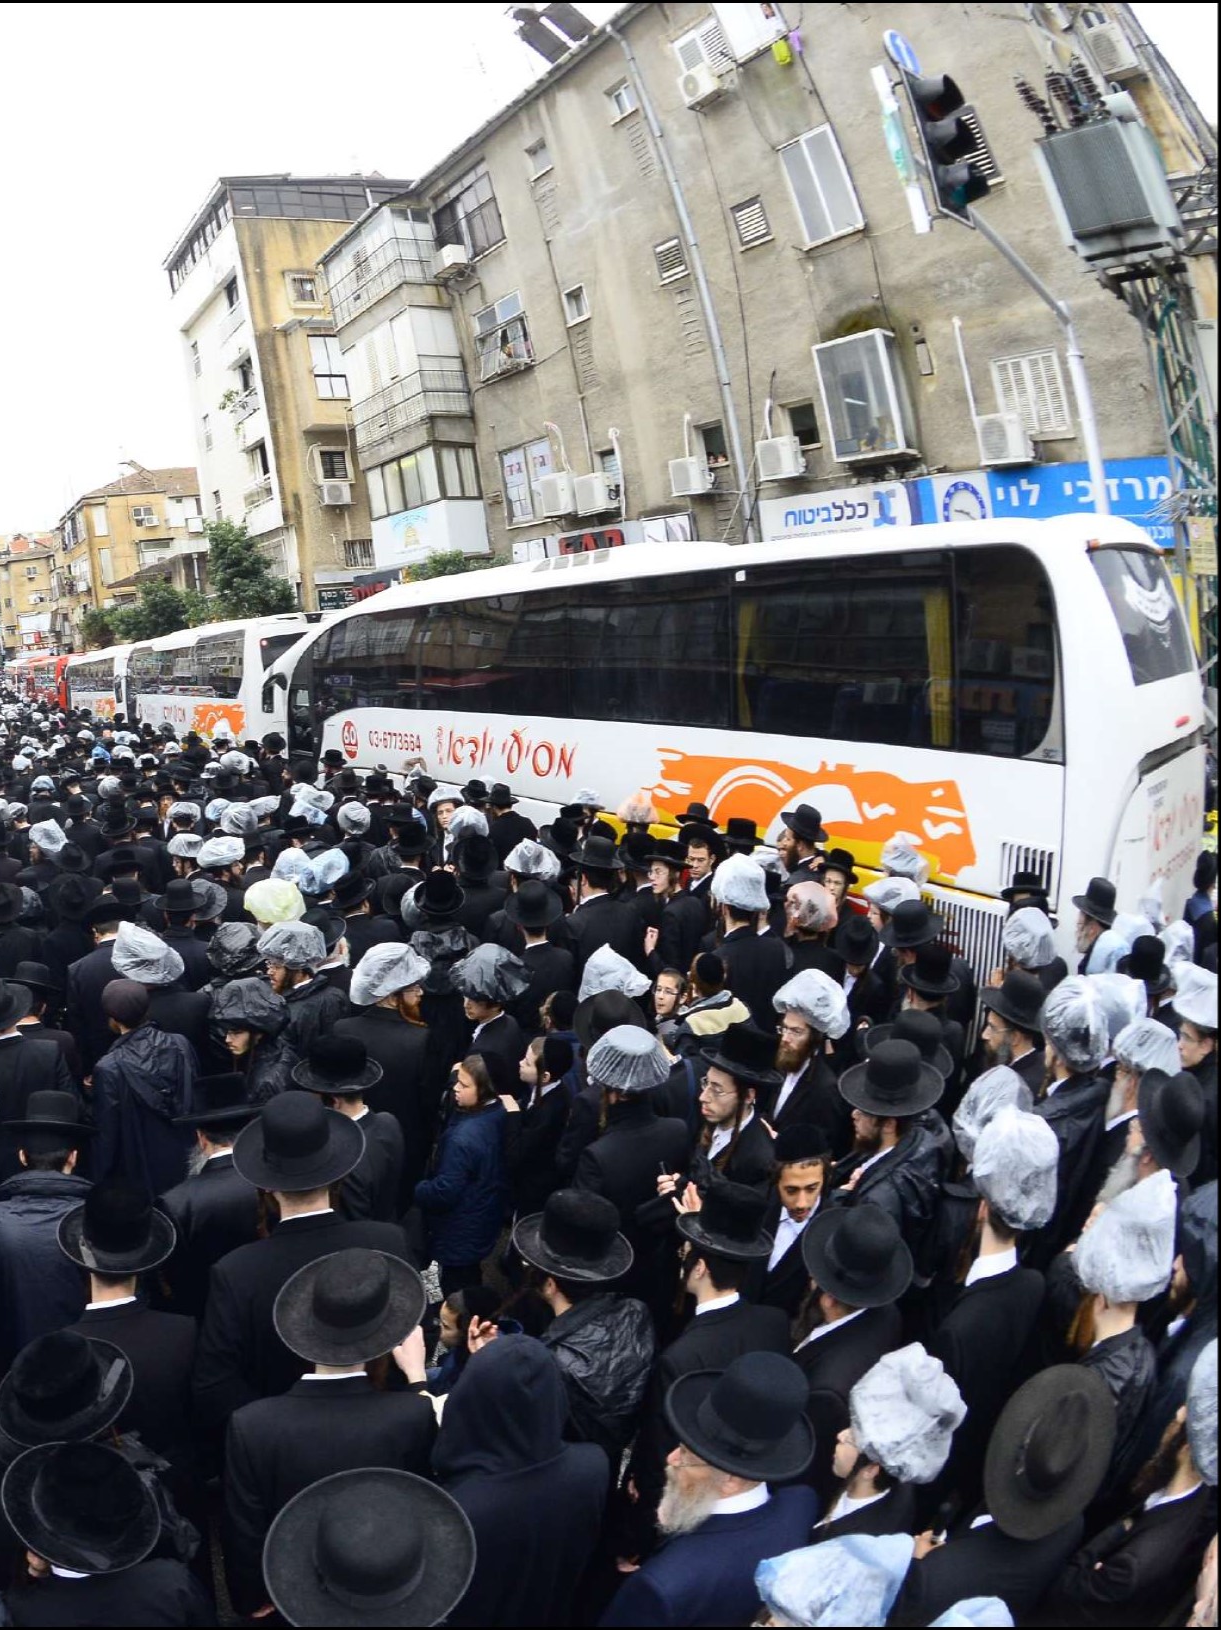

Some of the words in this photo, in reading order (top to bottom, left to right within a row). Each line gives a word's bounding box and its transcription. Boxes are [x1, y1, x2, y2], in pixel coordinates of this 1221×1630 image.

[996, 478, 1040, 507] לוי
[1063, 475, 1172, 503] מרדכי
[368, 729, 422, 753] 03-6773664
